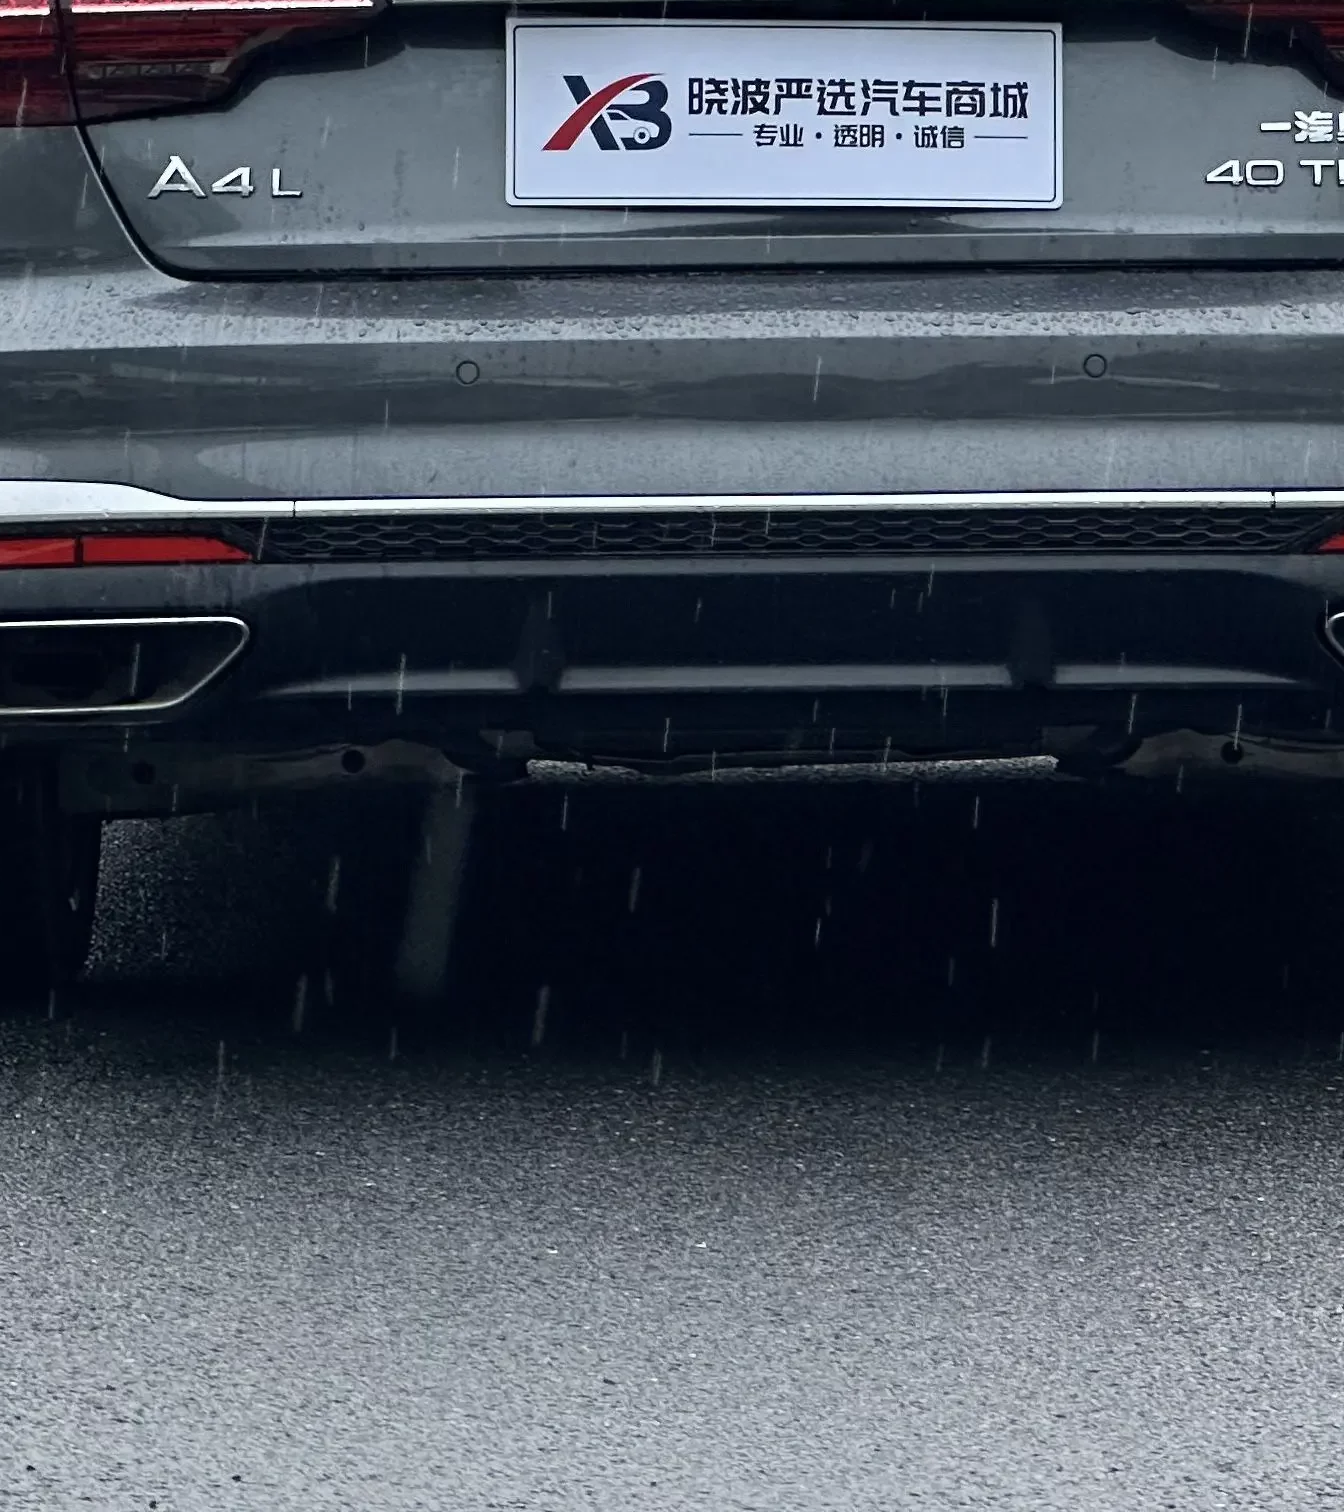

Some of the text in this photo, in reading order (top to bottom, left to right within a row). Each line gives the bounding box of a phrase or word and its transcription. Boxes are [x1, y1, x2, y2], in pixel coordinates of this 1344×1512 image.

[687, 77, 1029, 119] 晓波严选汽车商城
[1206, 159, 1285, 187] 40
